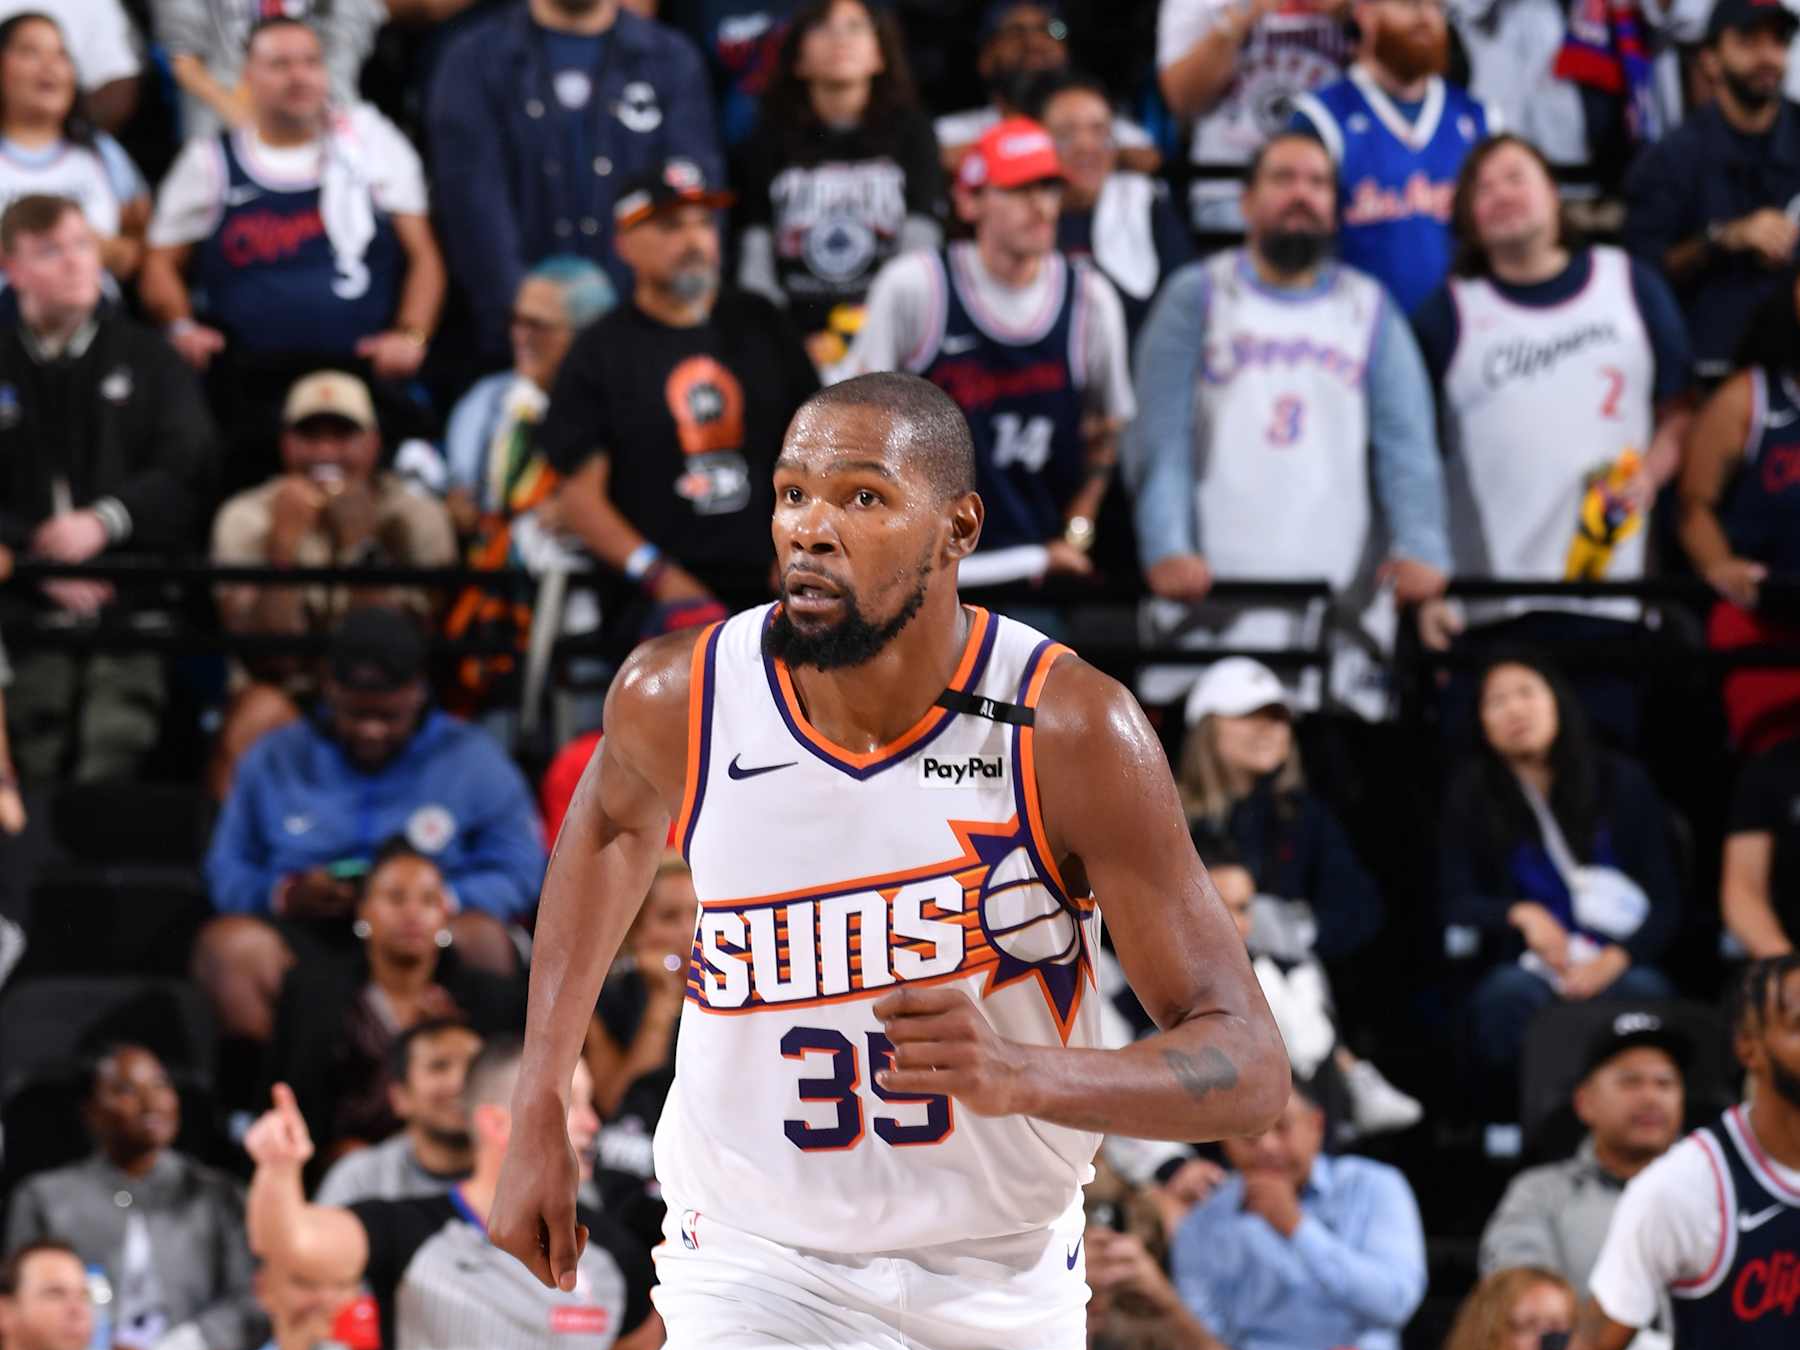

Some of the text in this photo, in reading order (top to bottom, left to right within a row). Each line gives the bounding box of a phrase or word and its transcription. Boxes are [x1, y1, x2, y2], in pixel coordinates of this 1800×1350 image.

[1266, 394, 1305, 447] 3
[1599, 366, 1624, 421] 2
[992, 414, 1052, 471] 14
[979, 700, 995, 718] AL
[923, 757, 1003, 784] PayPal
[700, 876, 964, 1008] SUNS
[780, 1026, 955, 1152] 35
